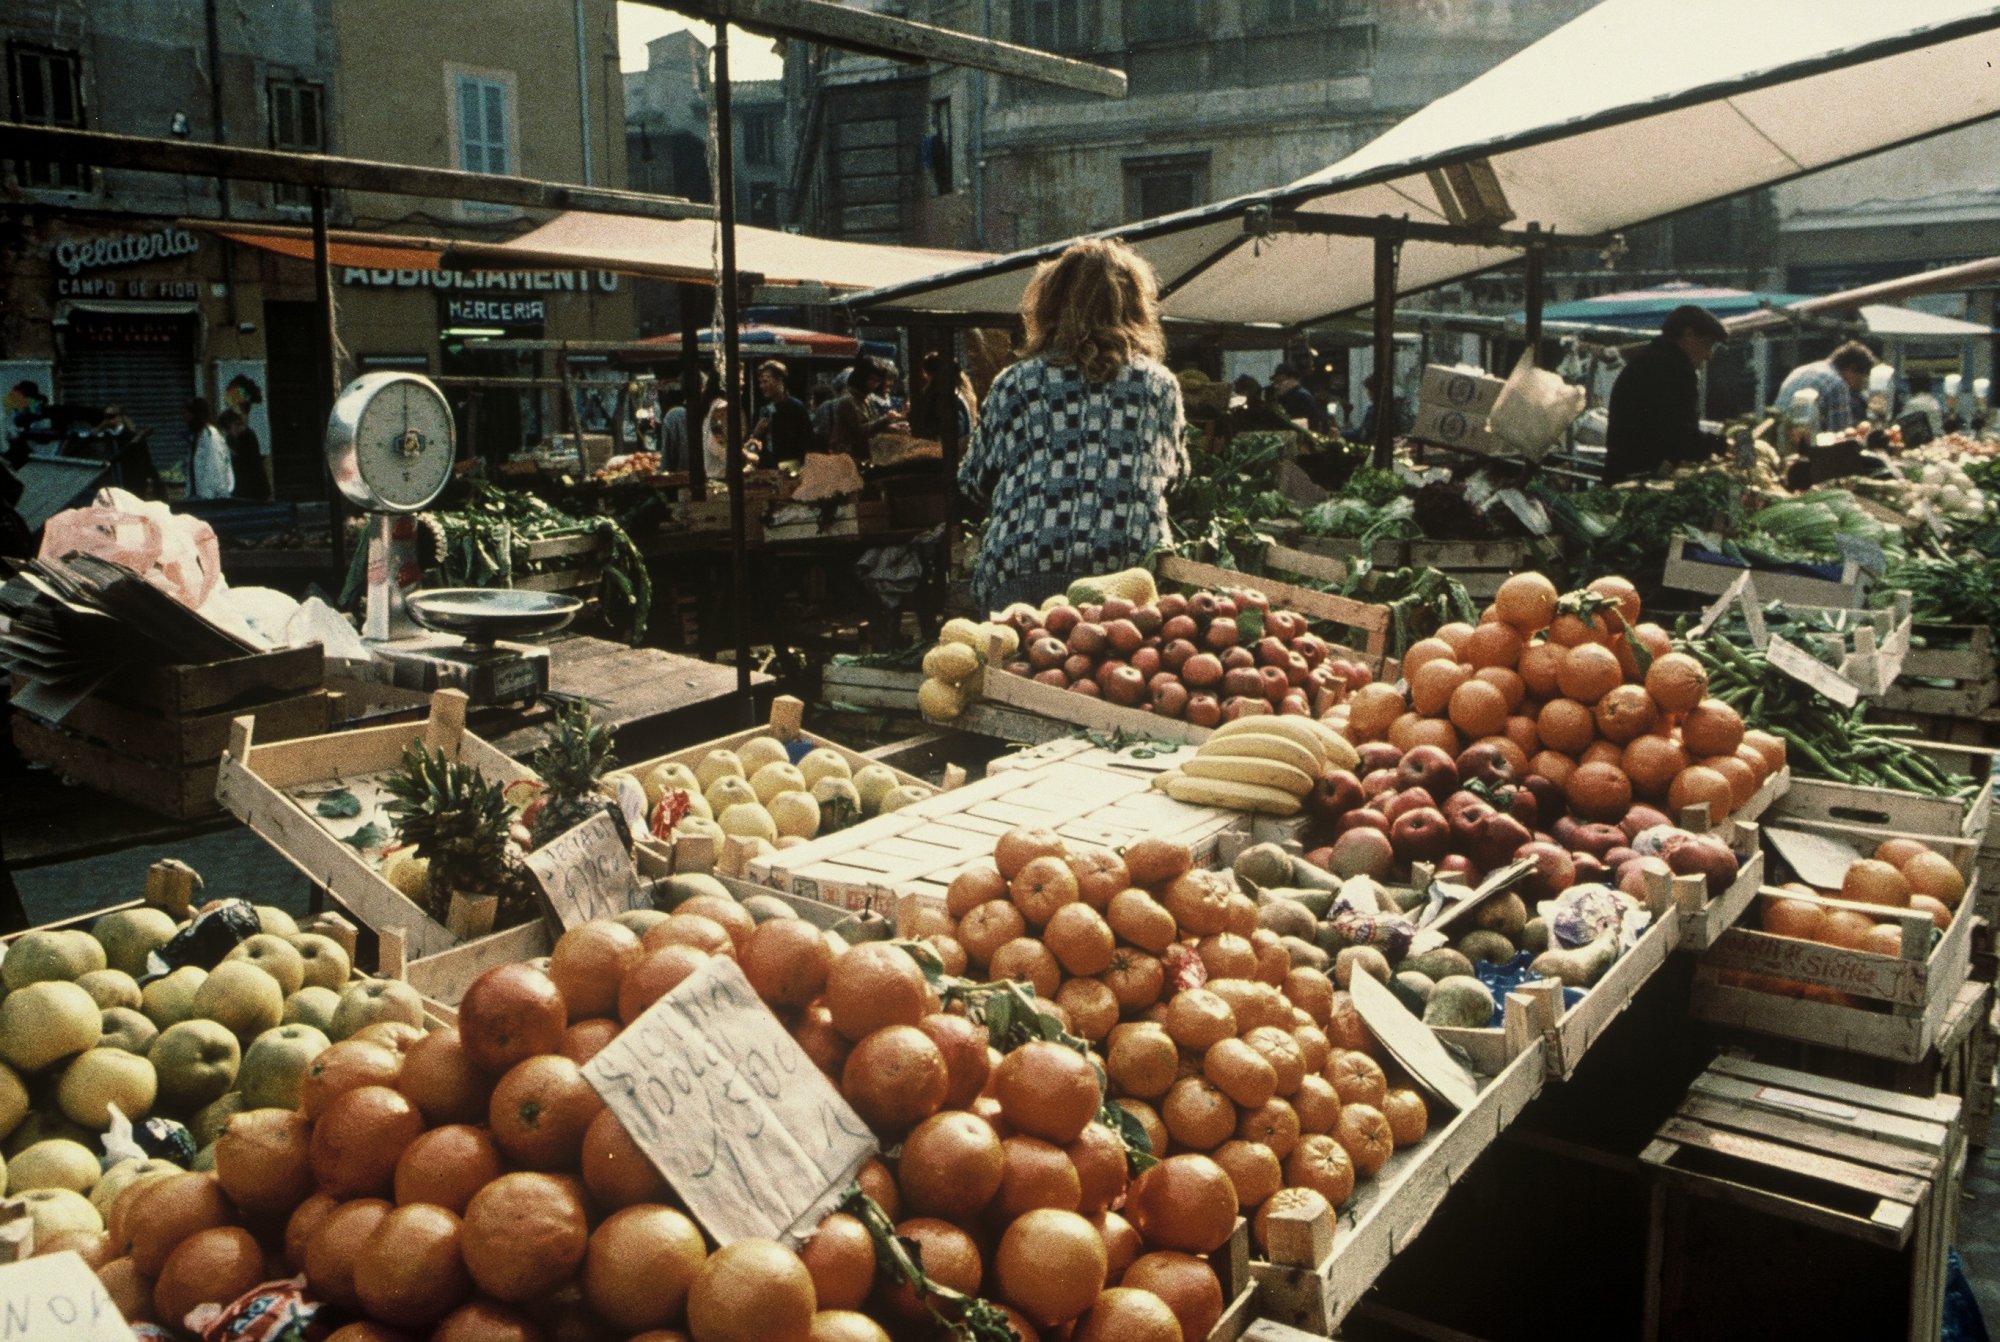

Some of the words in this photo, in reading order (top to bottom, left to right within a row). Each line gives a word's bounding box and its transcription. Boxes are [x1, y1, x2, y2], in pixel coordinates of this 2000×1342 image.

[56, 228, 199, 275] Gelateria
[58, 279, 116, 297] CAMPO
[128, 280, 150, 298] DE
[449, 301, 544, 320] MERCERIA
